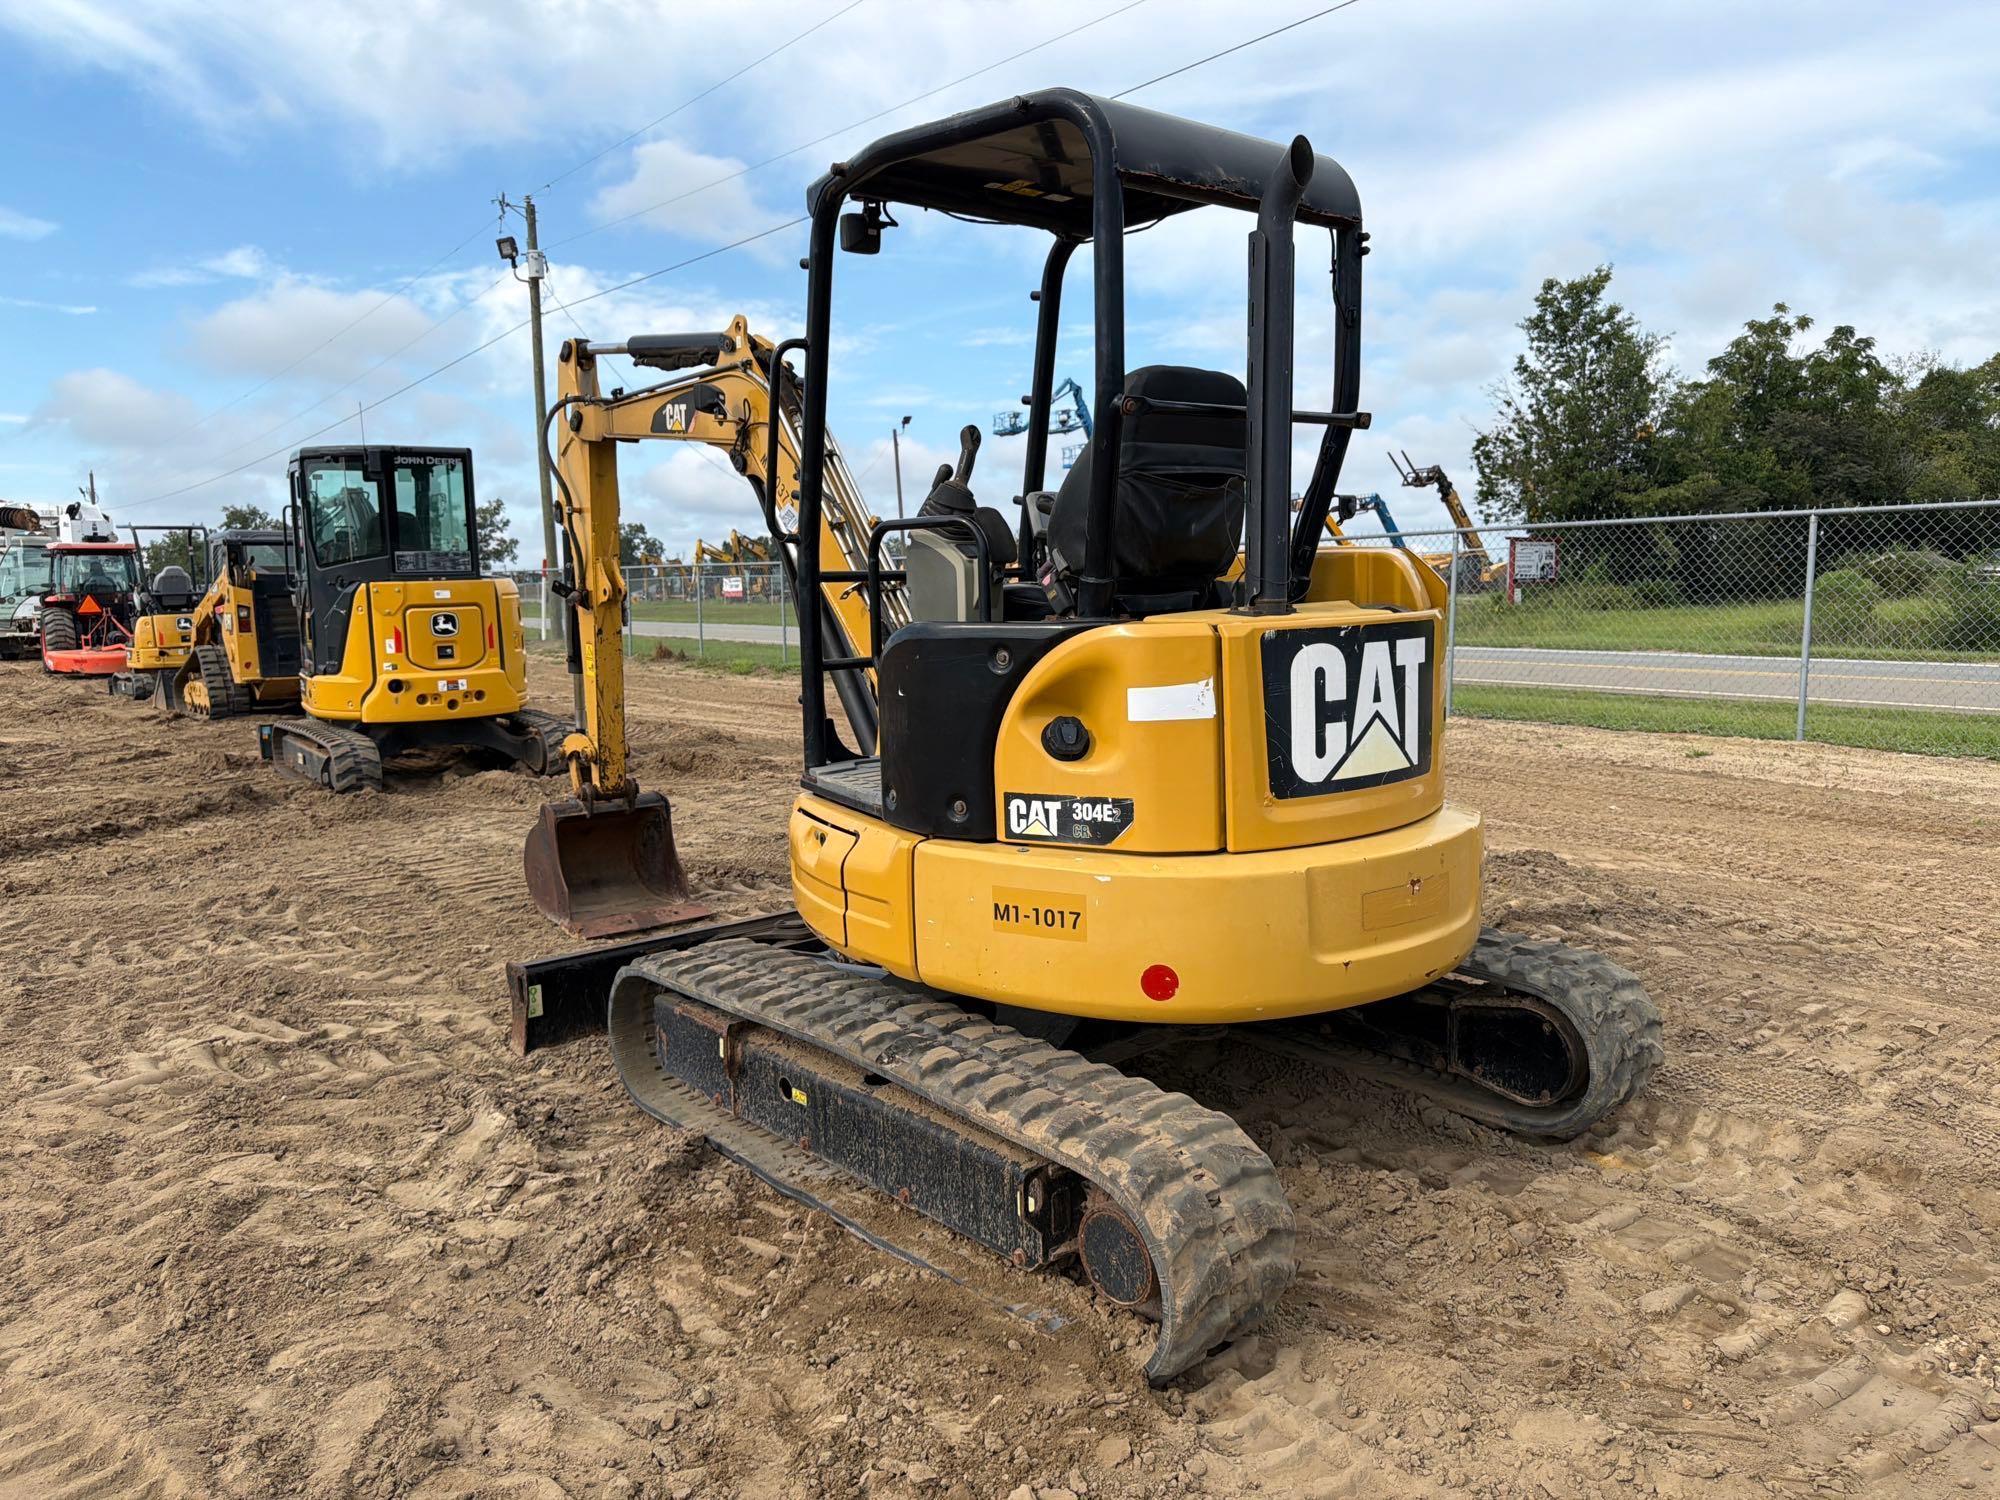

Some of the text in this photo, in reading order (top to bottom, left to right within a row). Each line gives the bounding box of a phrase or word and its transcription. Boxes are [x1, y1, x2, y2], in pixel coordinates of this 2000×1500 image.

[665, 403, 687, 431] CAT
[1290, 636, 1426, 783] CAT
[1009, 798, 1062, 837] CAT
[993, 902, 1081, 930] M1-1017
